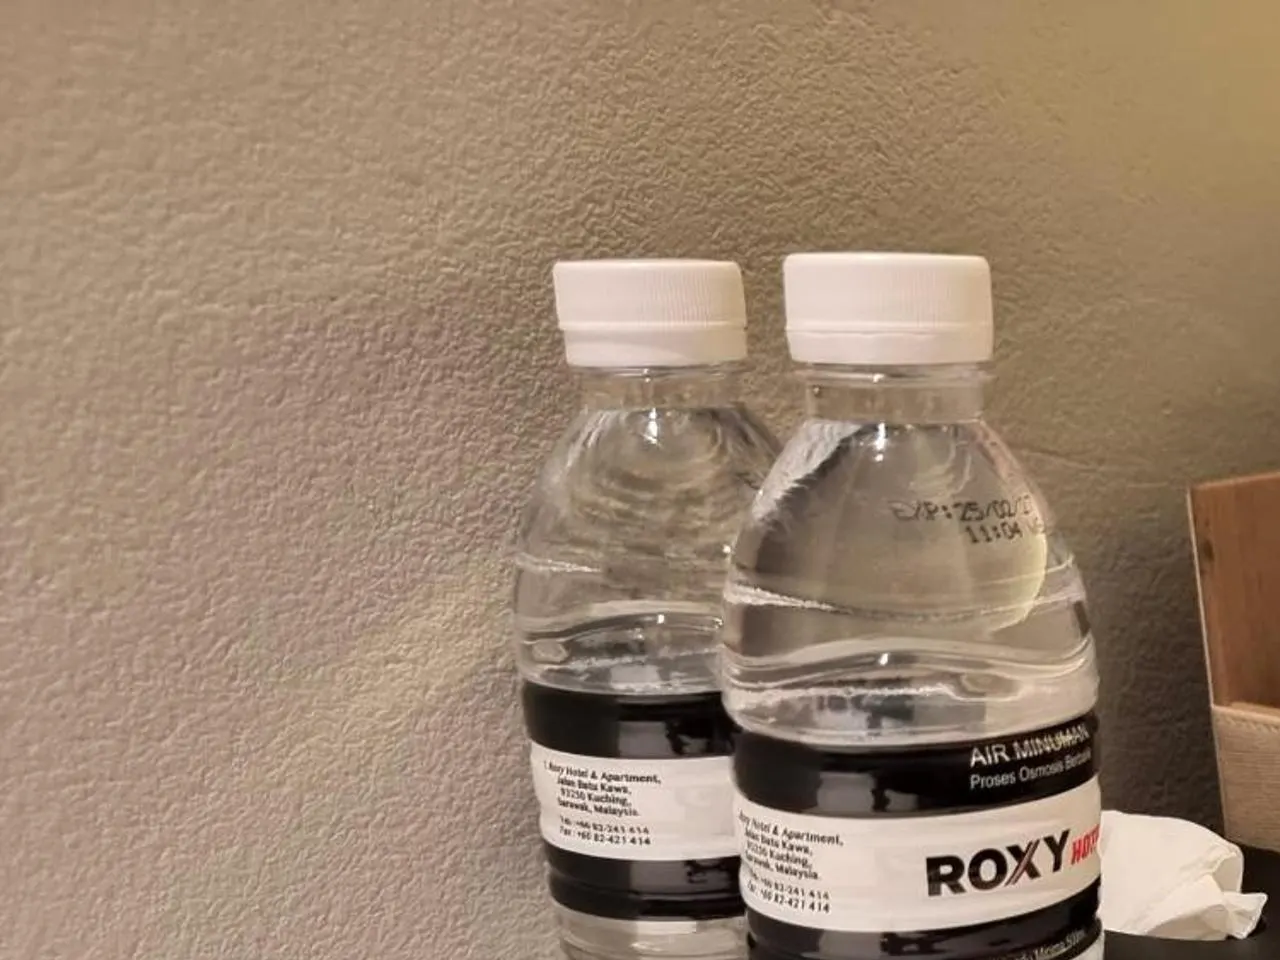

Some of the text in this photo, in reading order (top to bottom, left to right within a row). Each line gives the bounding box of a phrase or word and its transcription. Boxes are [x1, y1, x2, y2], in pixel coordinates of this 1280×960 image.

[970, 723, 1090, 768] AIR MINUMAN
[601, 771, 661, 784] Apartment,
[970, 771, 1016, 790] Proses
[782, 827, 844, 846] Apartment,
[926, 829, 1070, 896] ROXY
[808, 902, 830, 914] 414
